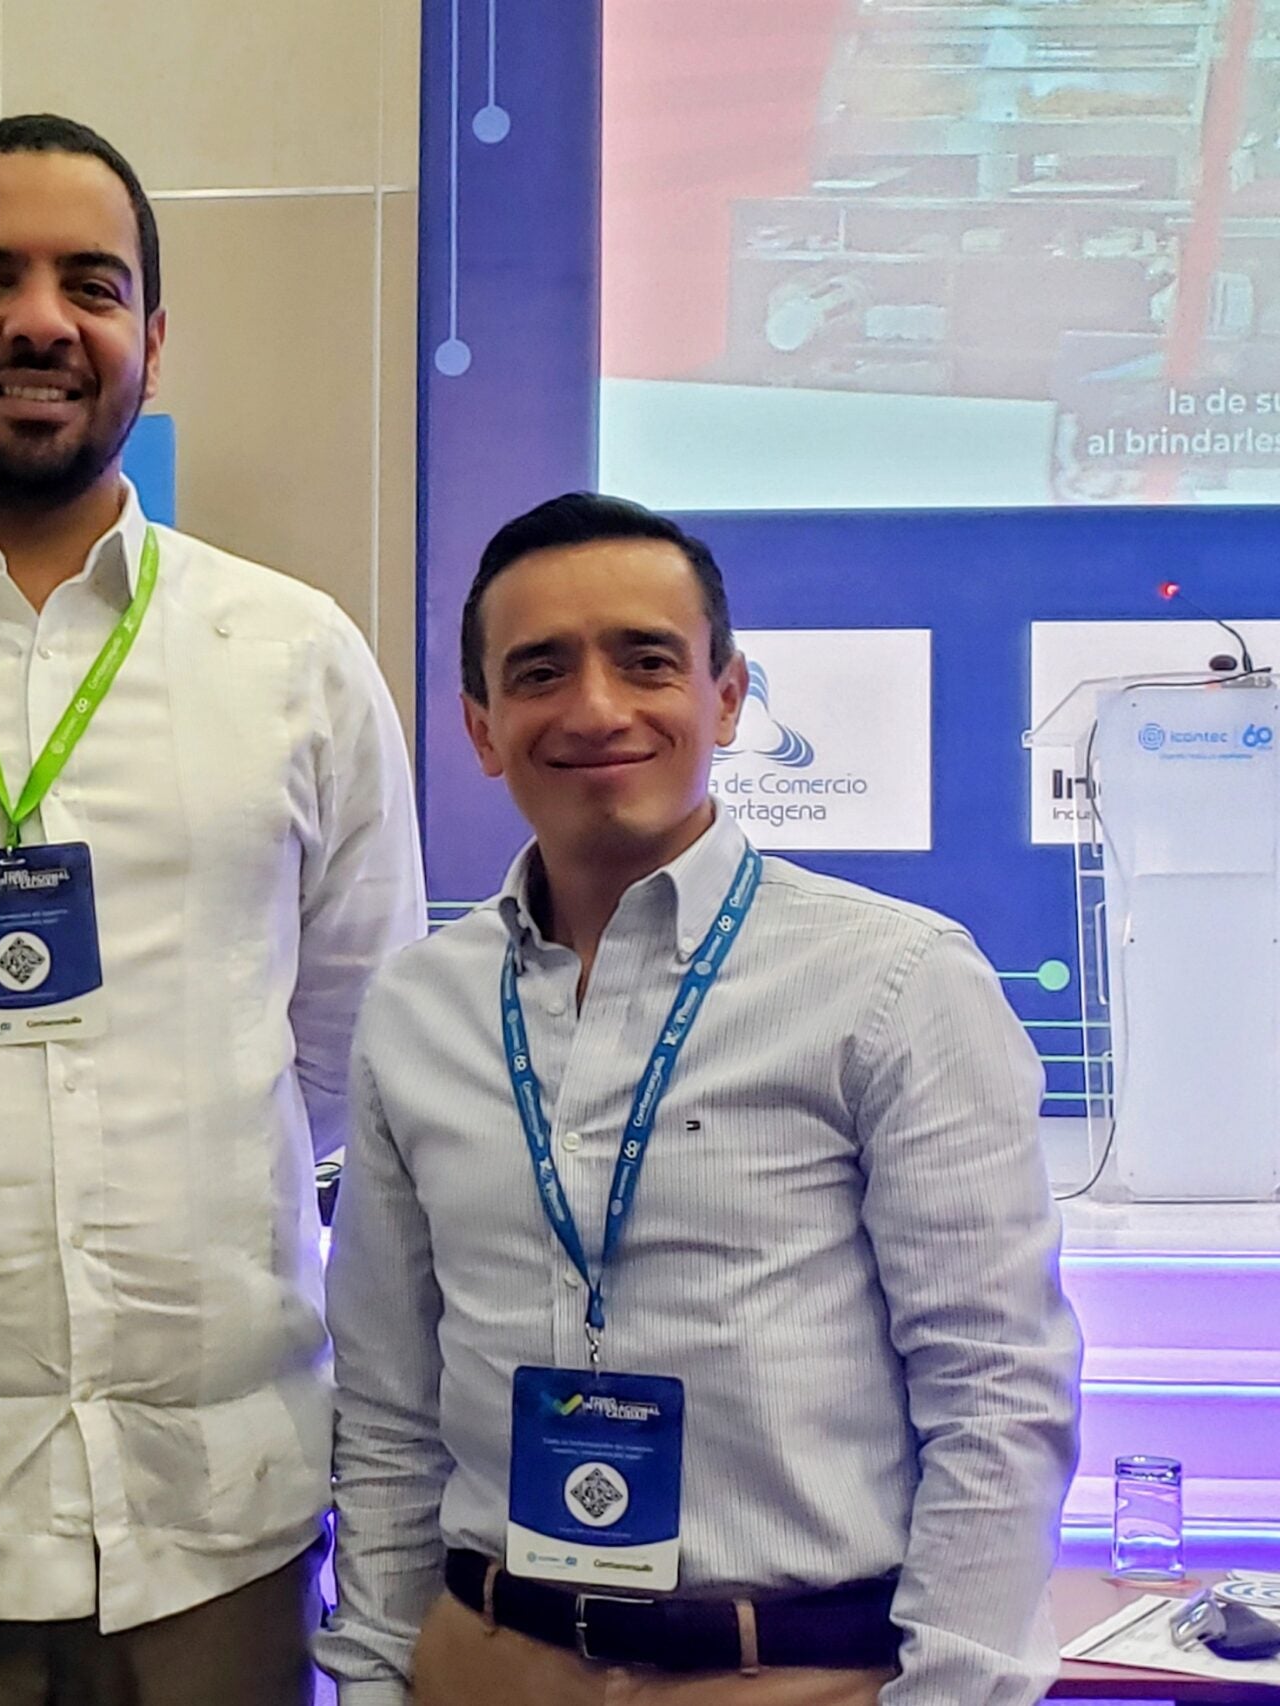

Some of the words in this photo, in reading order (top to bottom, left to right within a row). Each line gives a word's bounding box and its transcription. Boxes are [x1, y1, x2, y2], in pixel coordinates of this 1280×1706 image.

[1169, 387, 1196, 415] la
[1206, 387, 1246, 414] de
[1087, 428, 1114, 455] al
[1170, 731, 1228, 743] icontec
[1242, 723, 1273, 748] 60
[724, 772, 754, 794] de
[758, 772, 868, 795] Comercio
[726, 799, 827, 828] artagena
